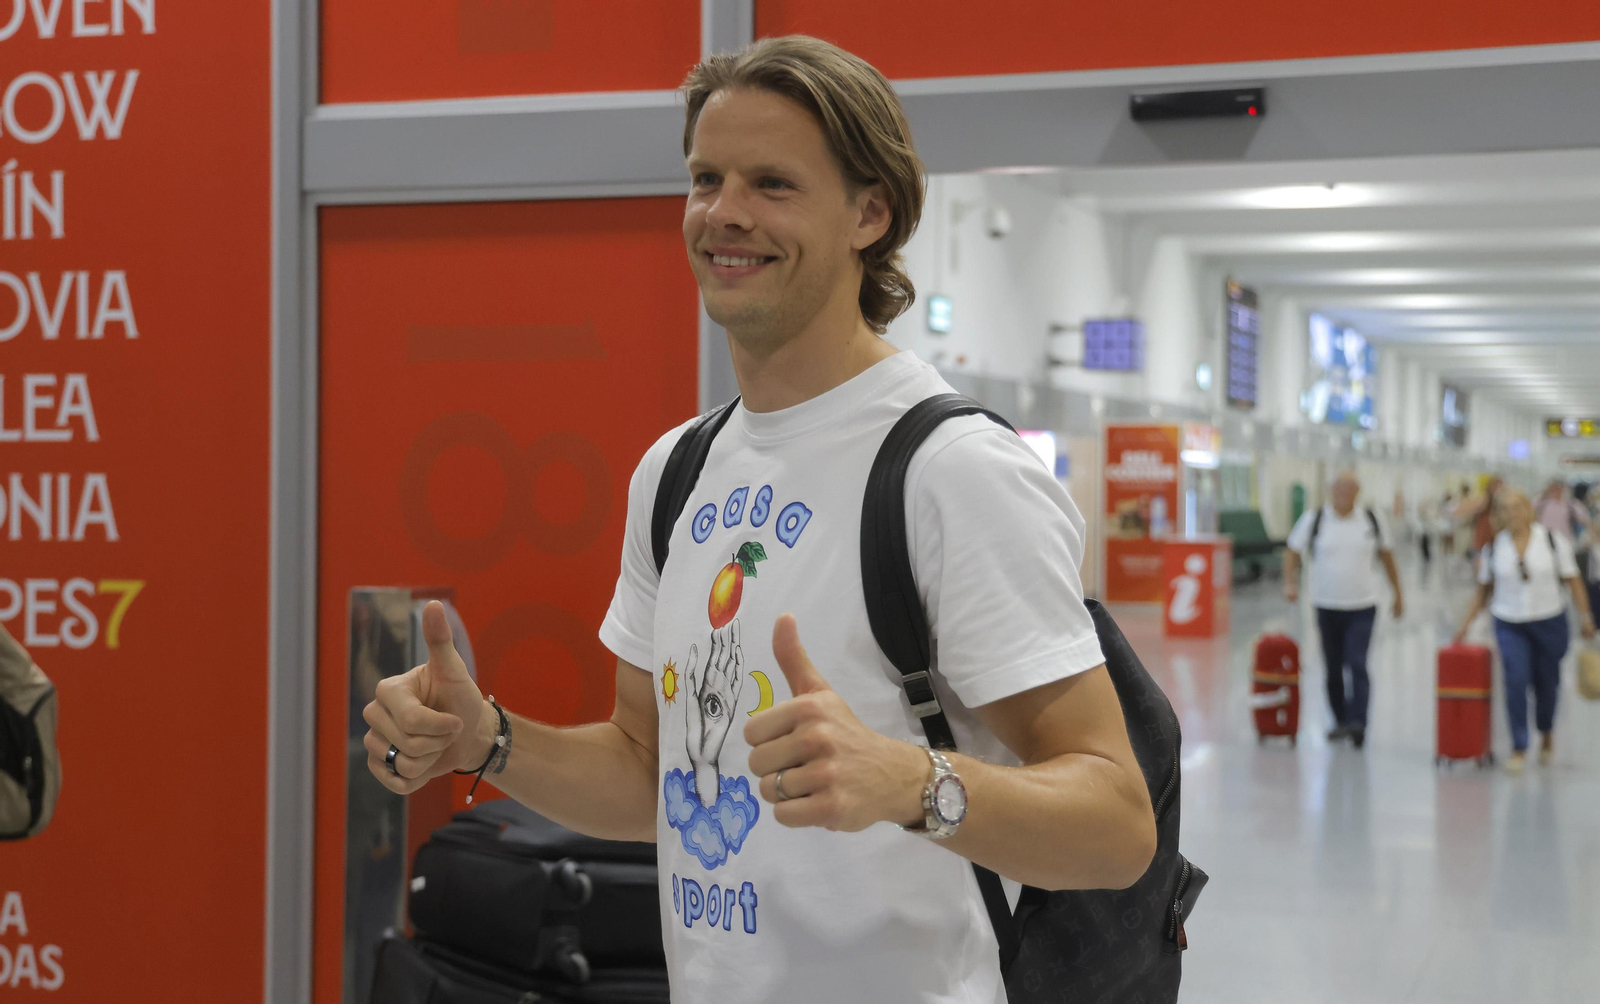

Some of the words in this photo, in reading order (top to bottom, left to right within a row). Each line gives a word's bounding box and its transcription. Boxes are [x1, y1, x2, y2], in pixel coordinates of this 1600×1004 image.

[0, 69, 139, 144] OW
[2, 158, 65, 240] ÍN
[0, 472, 120, 542] NIA
[692, 484, 813, 549] casa
[672, 873, 758, 934] sport
